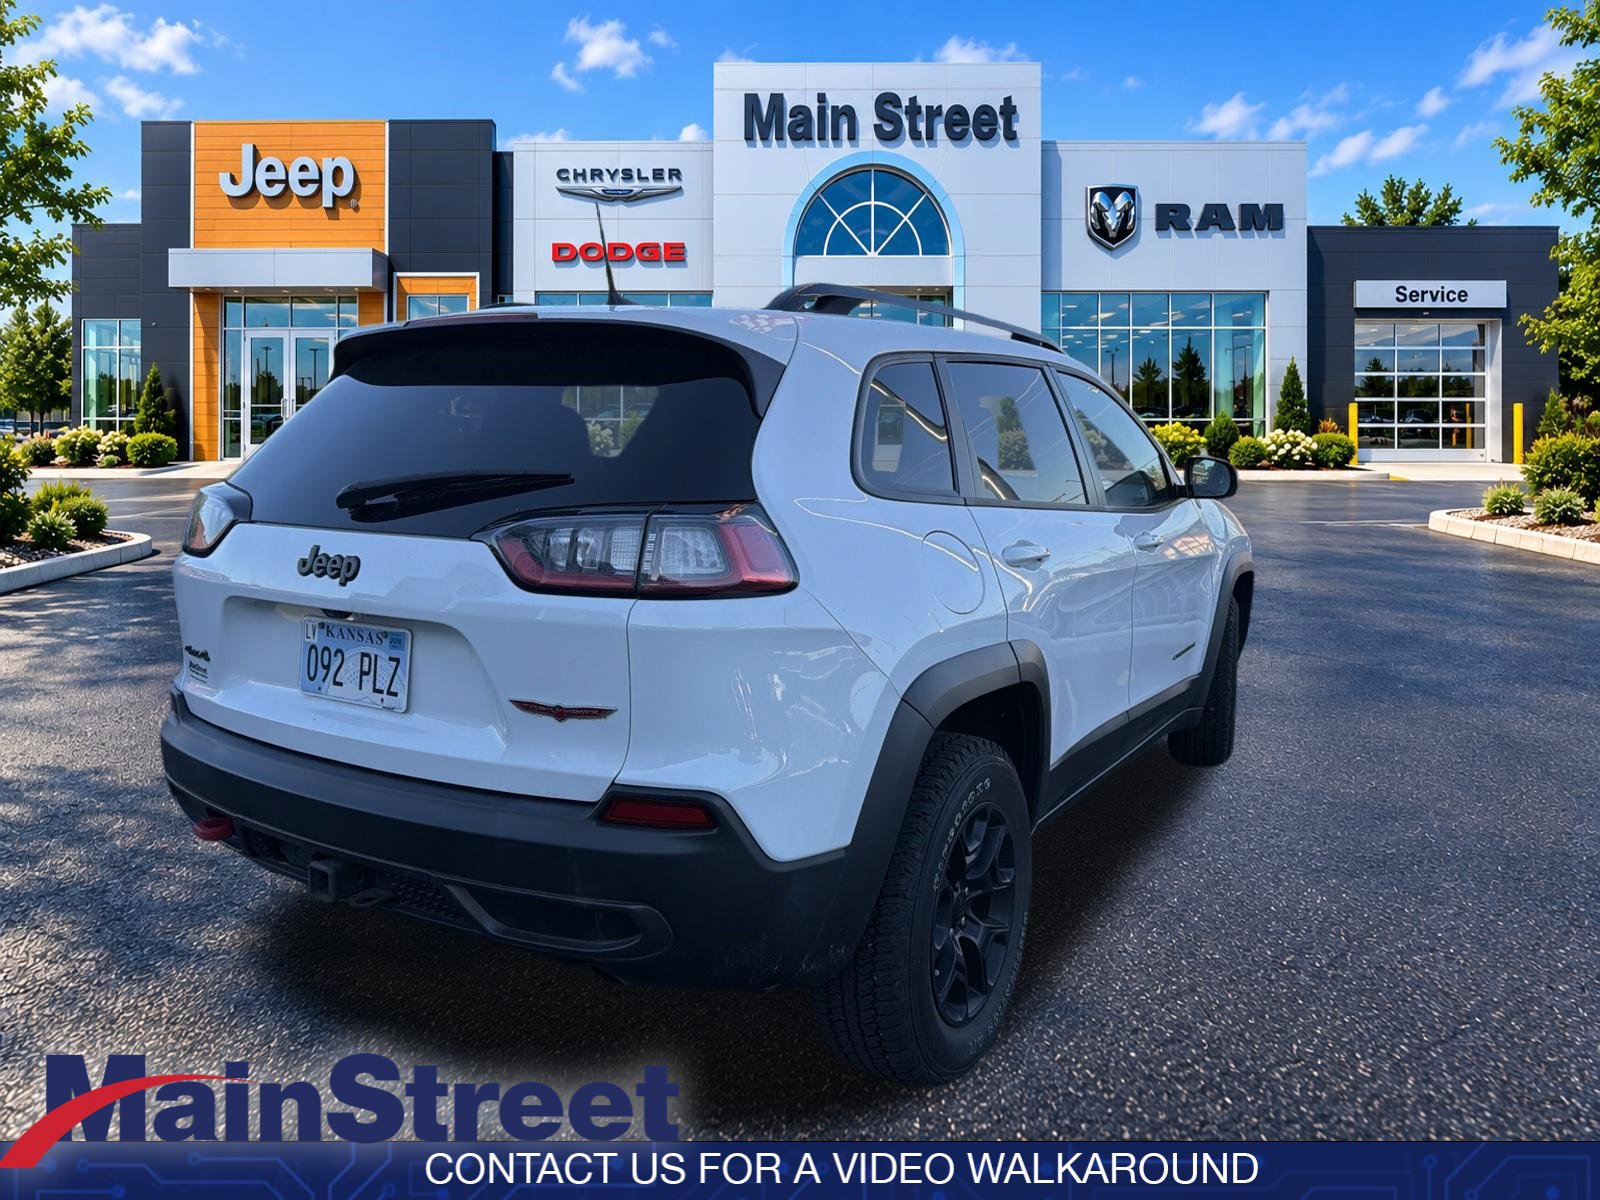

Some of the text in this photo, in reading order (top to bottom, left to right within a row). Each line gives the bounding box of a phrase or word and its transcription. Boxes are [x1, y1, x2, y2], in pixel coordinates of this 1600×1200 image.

[743, 91, 1017, 142] Main Street
[218, 143, 355, 209] Jeep
[556, 168, 682, 182] CHRYSLER
[1155, 203, 1284, 231] RAM
[551, 242, 686, 262] DODGE
[1395, 285, 1469, 303] Service
[297, 544, 361, 587] Jeep
[305, 623, 317, 640] LV
[325, 624, 384, 645] KANSAS
[307, 644, 401, 698] 092 PLZ
